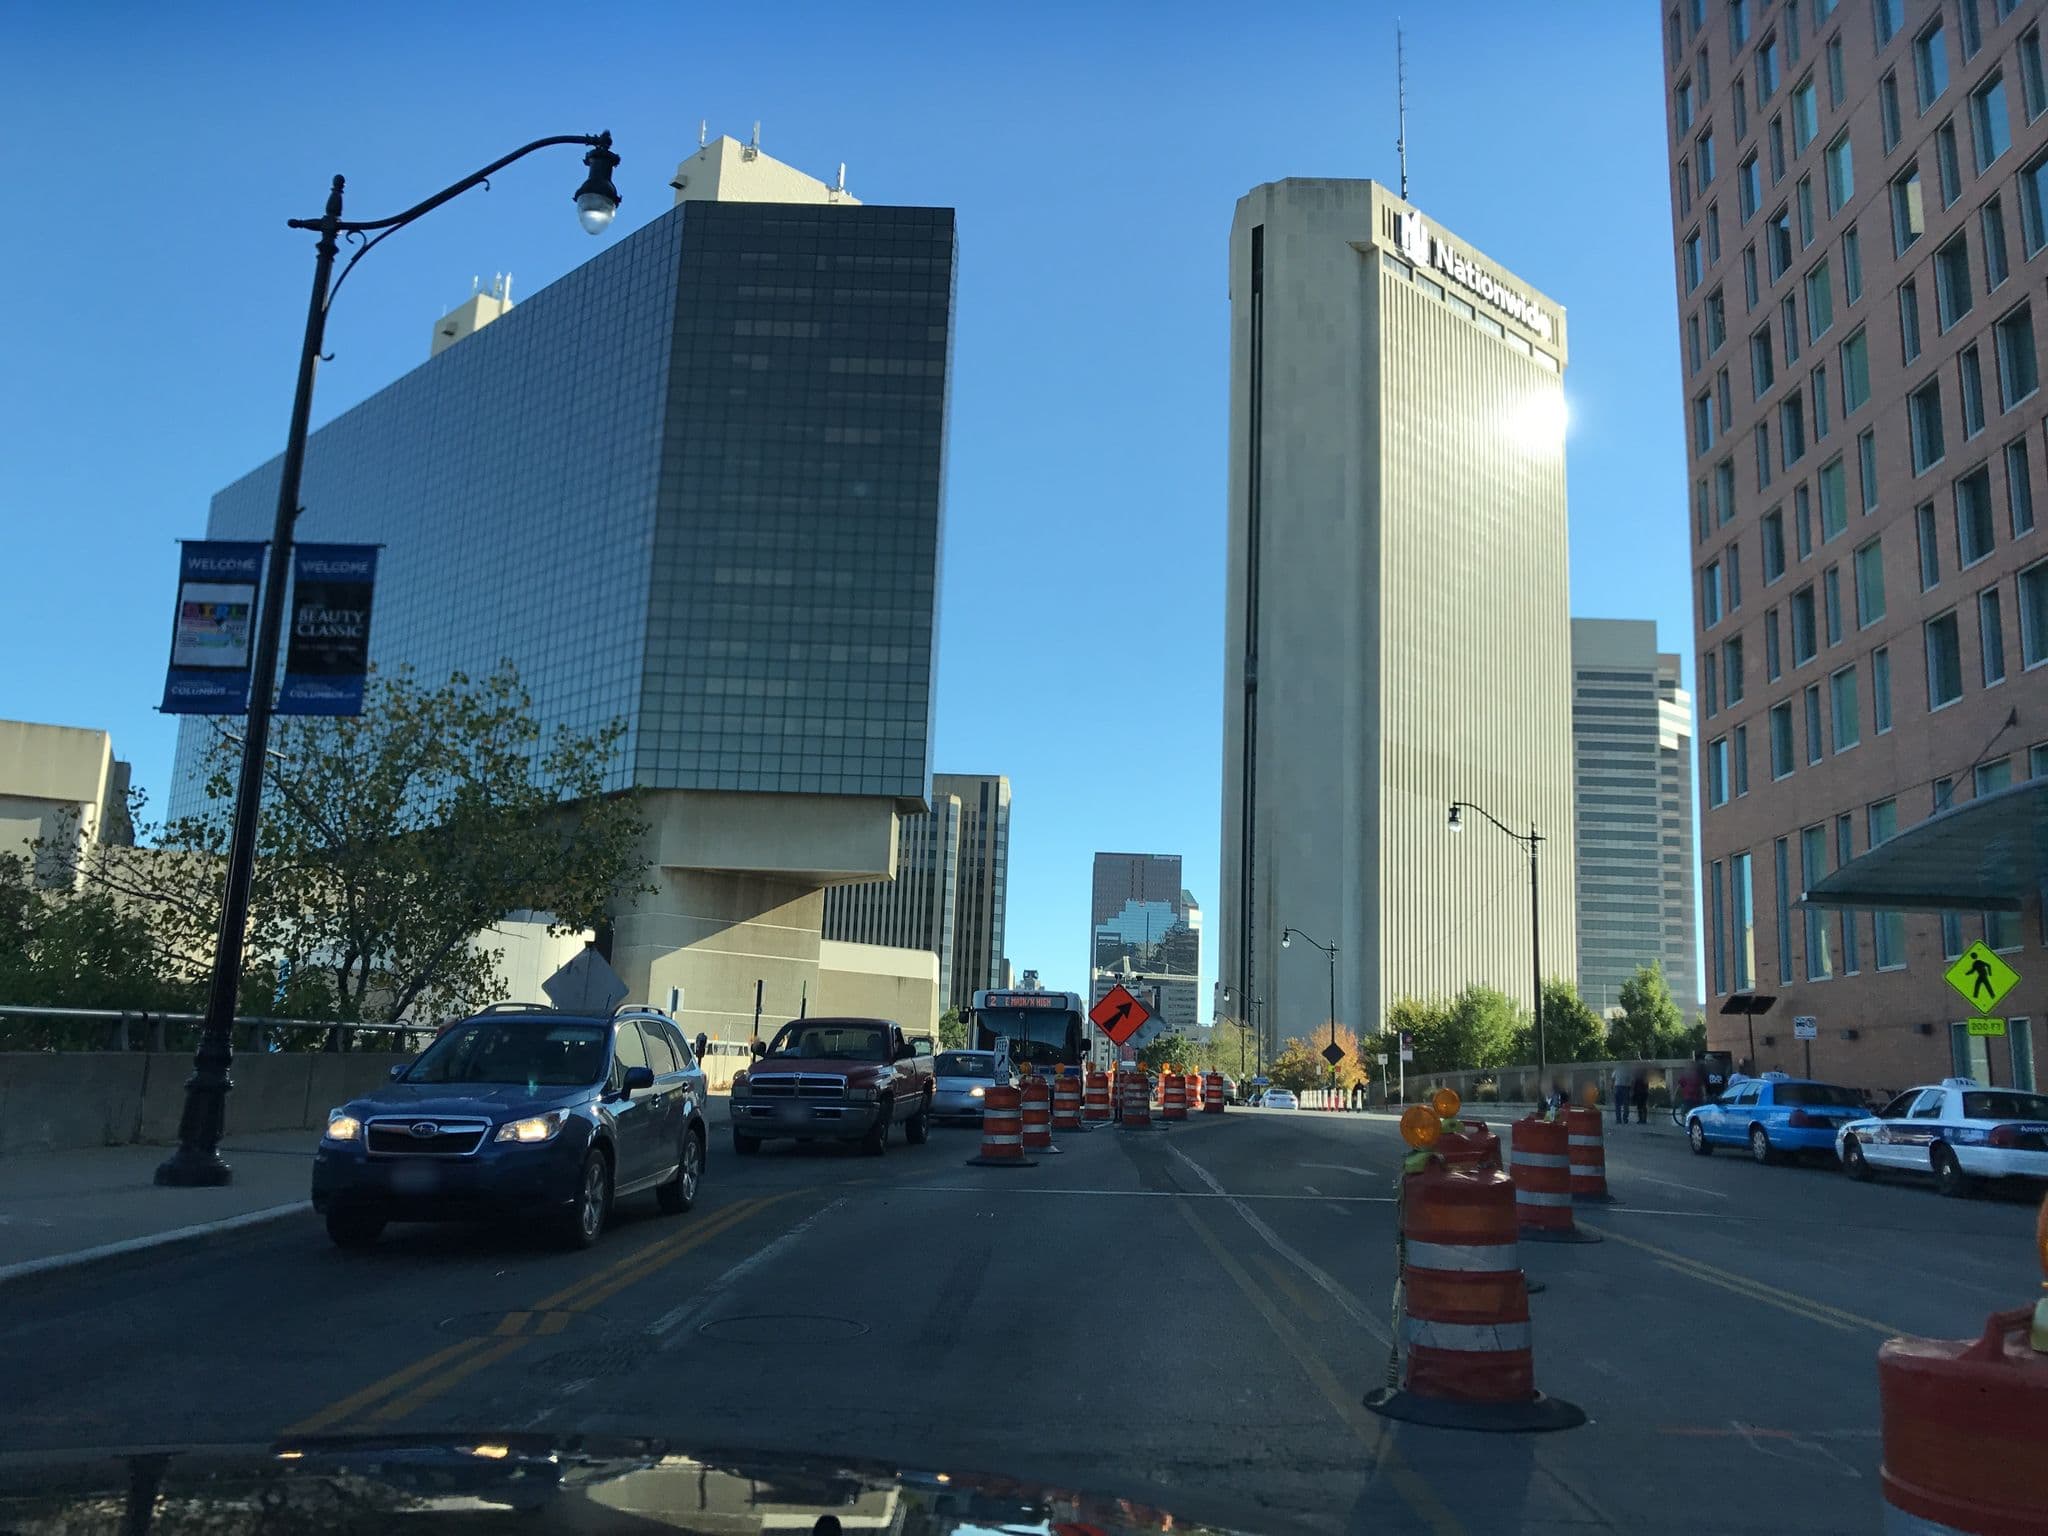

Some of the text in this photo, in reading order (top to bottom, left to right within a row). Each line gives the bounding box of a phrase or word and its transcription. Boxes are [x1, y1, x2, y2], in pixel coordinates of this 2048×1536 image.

[1436, 238, 1551, 341] Nationwide
[187, 557, 257, 571] WELCOME
[300, 560, 369, 574] WELCOME
[298, 608, 365, 625] BEAUTY
[295, 624, 364, 638] CLASSIC
[990, 996, 997, 1006] 2
[1971, 1022, 1988, 1031] 200
